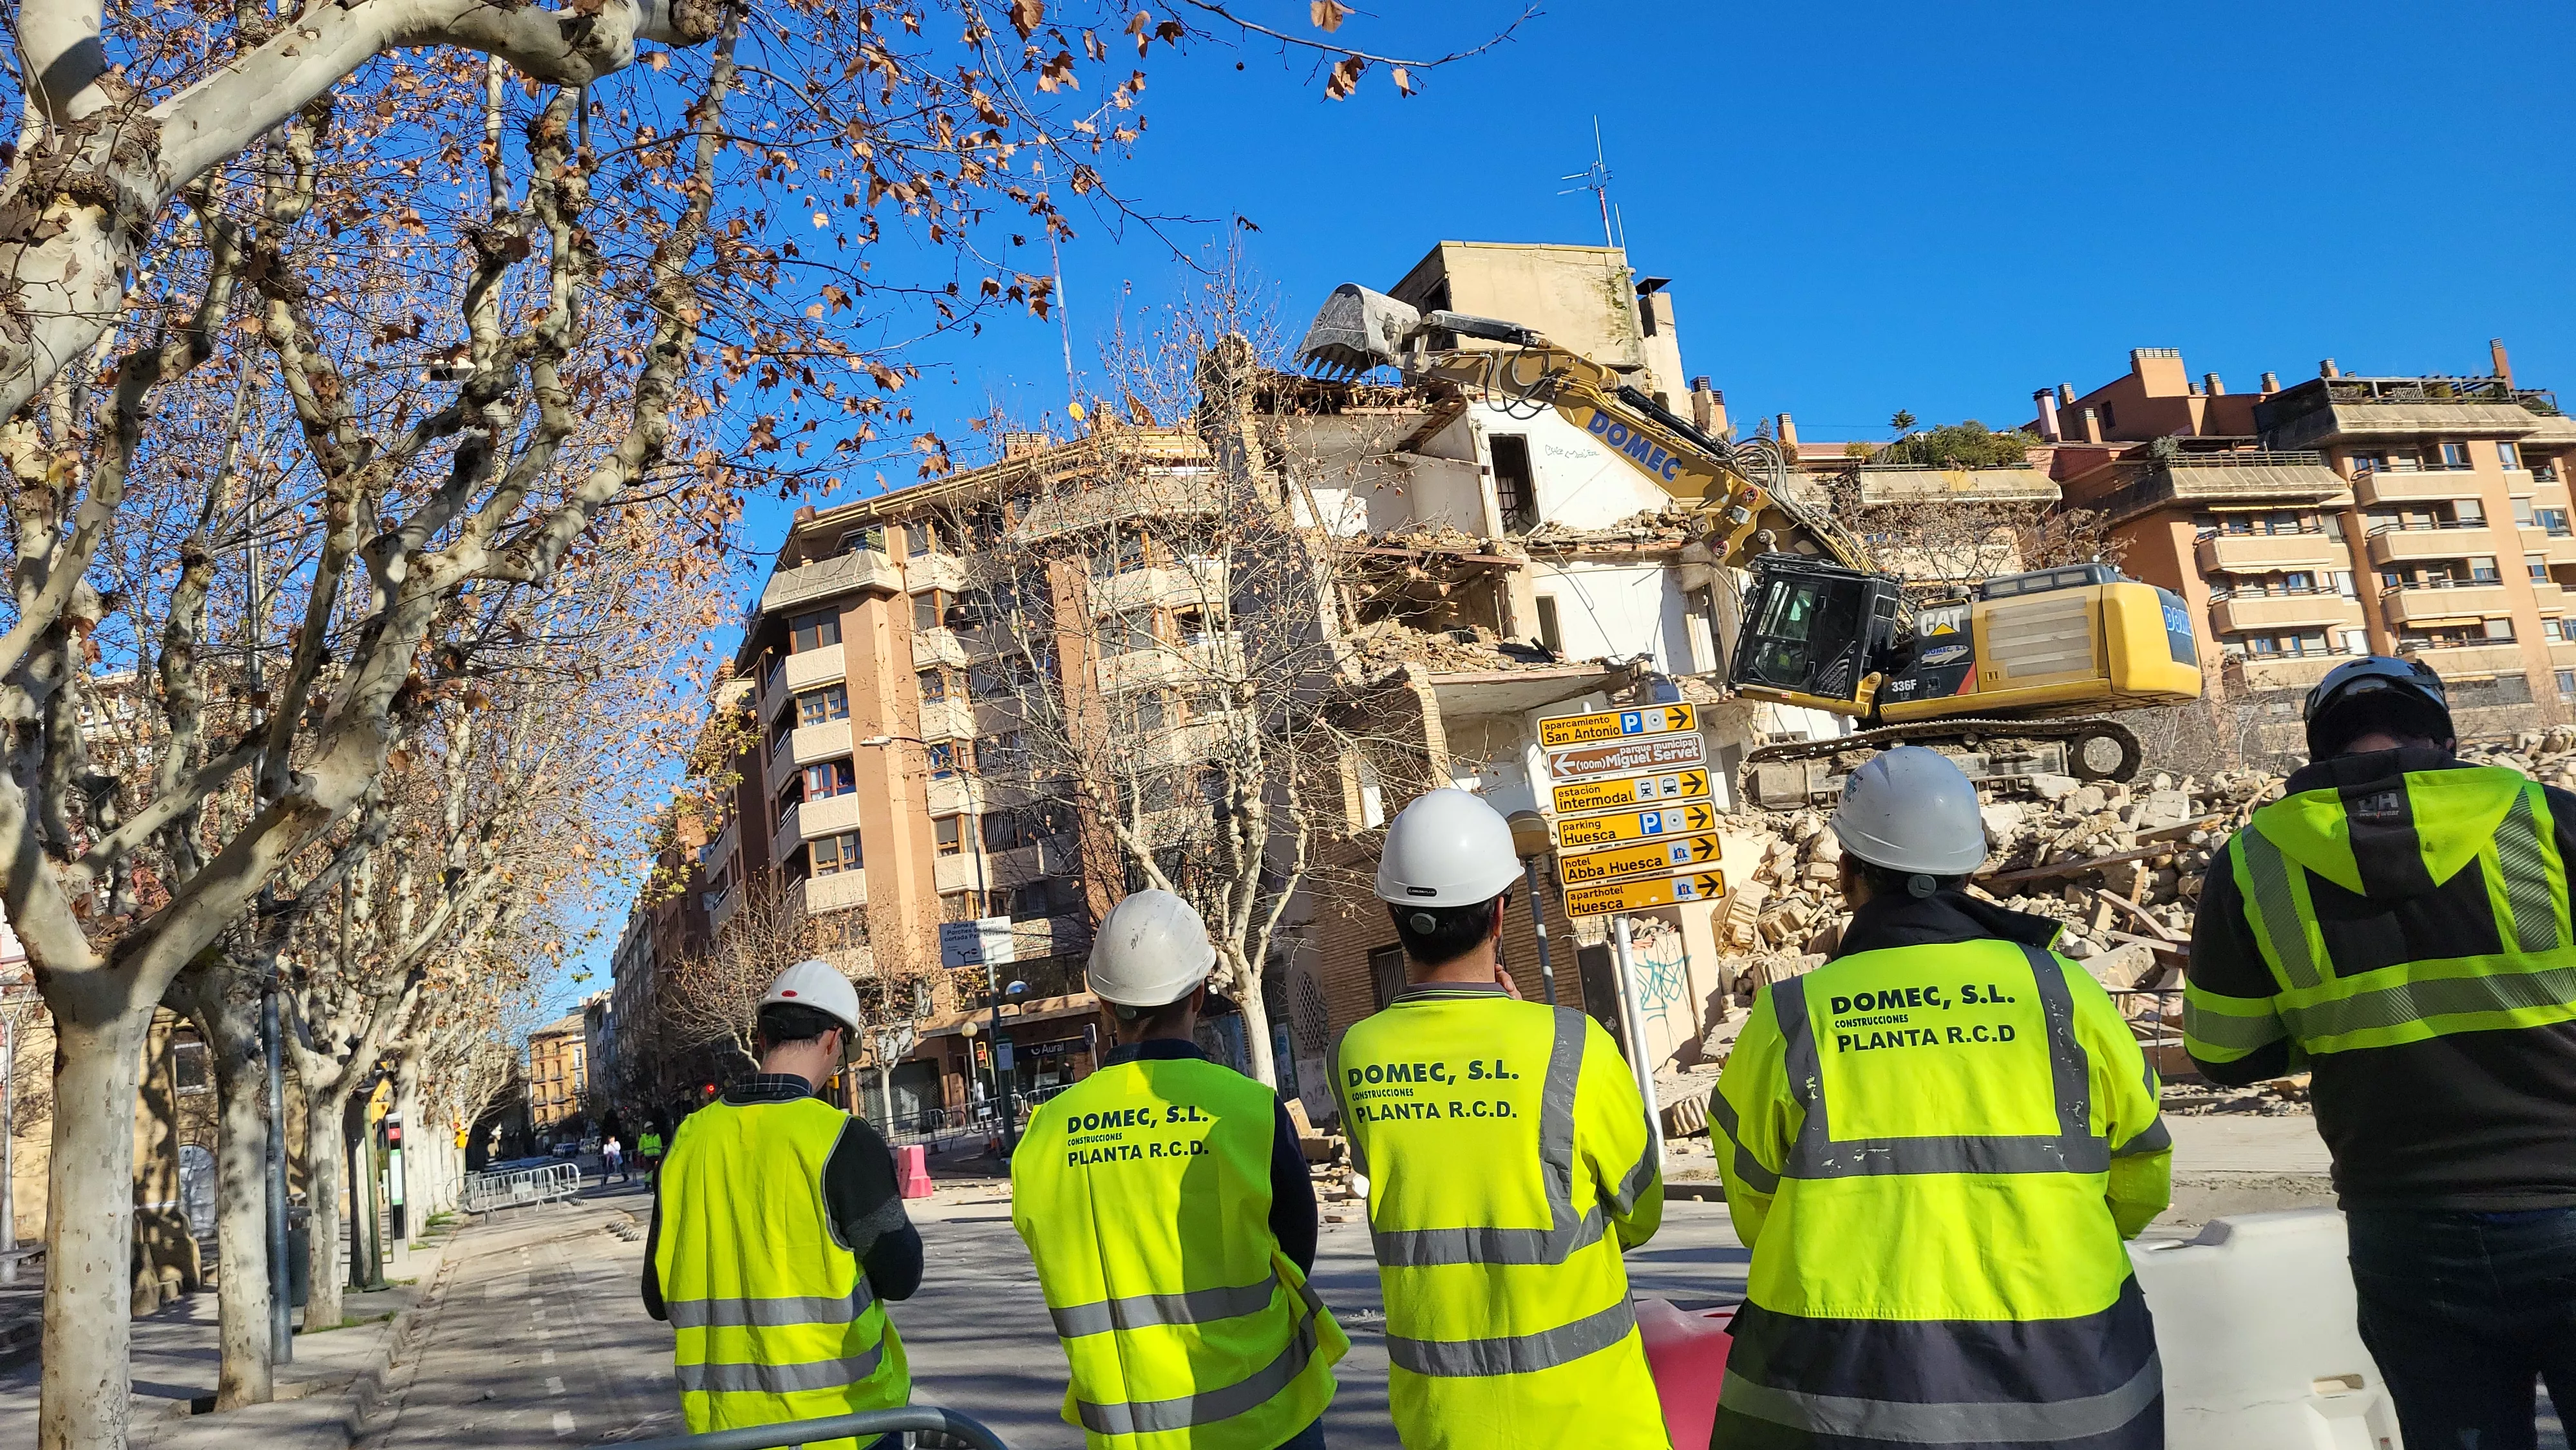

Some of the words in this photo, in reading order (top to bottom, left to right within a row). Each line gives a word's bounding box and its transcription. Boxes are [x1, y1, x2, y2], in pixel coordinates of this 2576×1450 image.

[1587, 410, 1682, 482] DOMEC
[1920, 608, 1964, 637] CAT
[1891, 679, 1917, 692] 336F
[1544, 715, 1610, 730] aparcamiento
[1624, 714, 1638, 732] P
[1546, 732, 1569, 743] San
[1575, 726, 1620, 740] Antonio
[1620, 744, 1652, 756] parque
[1653, 738, 1698, 752] municipal
[1576, 758, 1605, 771] (100m)
[1605, 753, 1652, 768] Miguel
[1654, 746, 1699, 762] Servet
[1558, 784, 1600, 798] estación
[1559, 791, 1634, 810] intermodal
[1563, 820, 1601, 833] parking
[1643, 814, 1658, 834] P
[1564, 830, 1616, 845] Huesca
[1565, 857, 1591, 868] hotel
[1568, 867, 1605, 880] Abba
[1609, 857, 1663, 874] Huesca
[1570, 886, 1624, 900] aparthotel
[1571, 899, 1624, 914] Huesca
[1831, 986, 1951, 1015] DOMEC,
[1960, 984, 2015, 1004] S.L.
[1835, 1014, 1908, 1028] CONSTRUCCIONES
[1837, 1028, 1939, 1053] PLANTA
[1946, 1024, 2016, 1044] R.C.D
[1041, 1042, 1065, 1054] Aural
[1348, 1062, 1456, 1088] DOMEC,
[1468, 1059, 1519, 1080] S.L.
[1352, 1088, 1414, 1101] CONSTRUCCIONES
[1068, 1107, 1158, 1134] DOMEC,
[1166, 1106, 1209, 1123] S.L.
[1356, 1102, 1441, 1123] PLANTA
[1448, 1100, 1517, 1118] R.C.D.
[1068, 1133, 1122, 1147] CONSTRUCCIONES
[1068, 1144, 1142, 1167] PLANTA
[1150, 1140, 1209, 1158] R.C.D.
